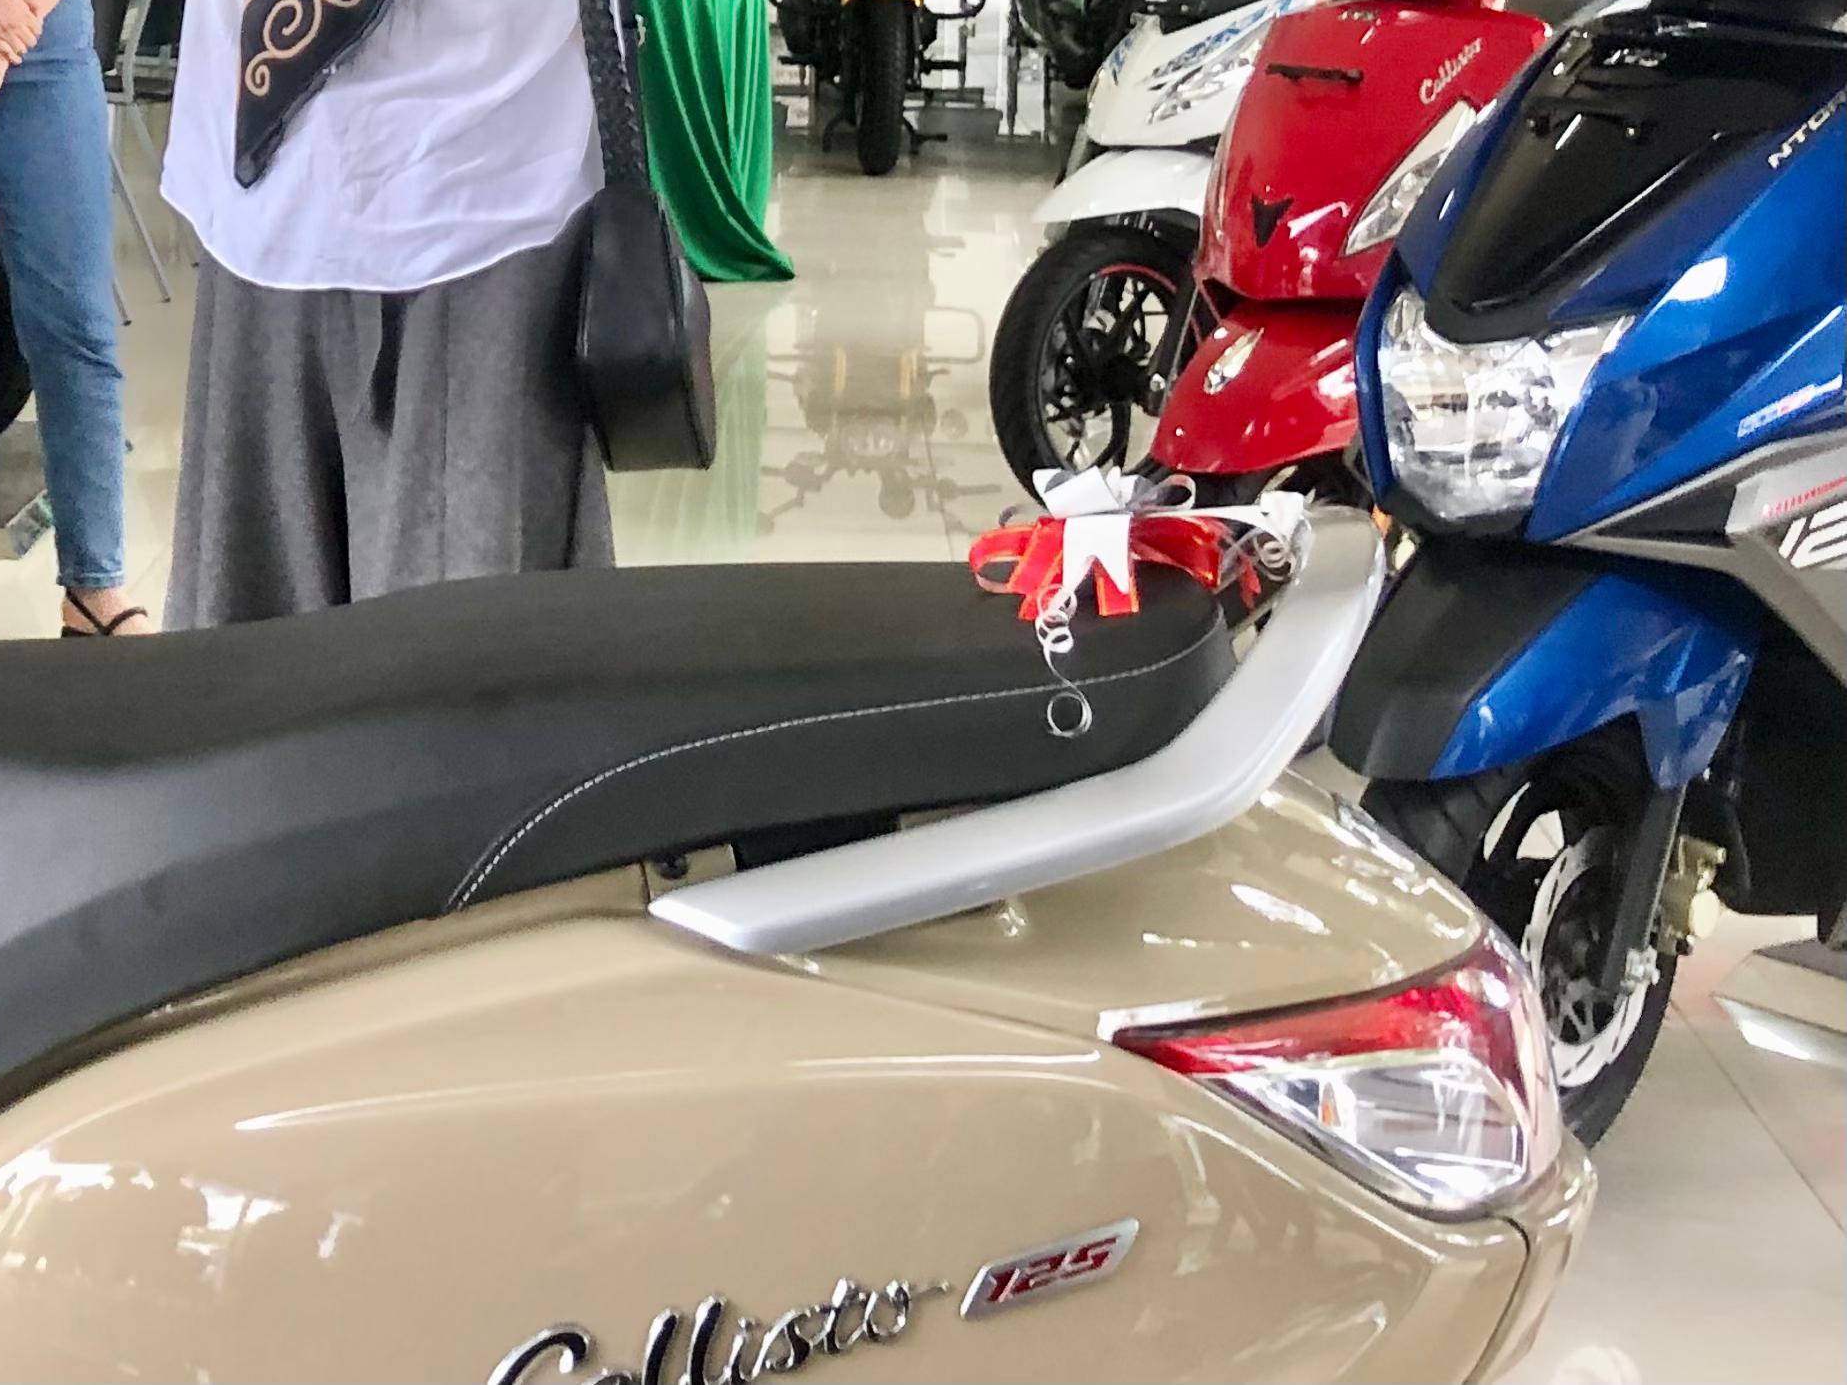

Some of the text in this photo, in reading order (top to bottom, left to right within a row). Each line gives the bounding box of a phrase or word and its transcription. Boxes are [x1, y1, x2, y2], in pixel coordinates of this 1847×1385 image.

[1418, 37, 1483, 105] Callisto
[486, 1235, 1119, 1385] Cllisto 125
